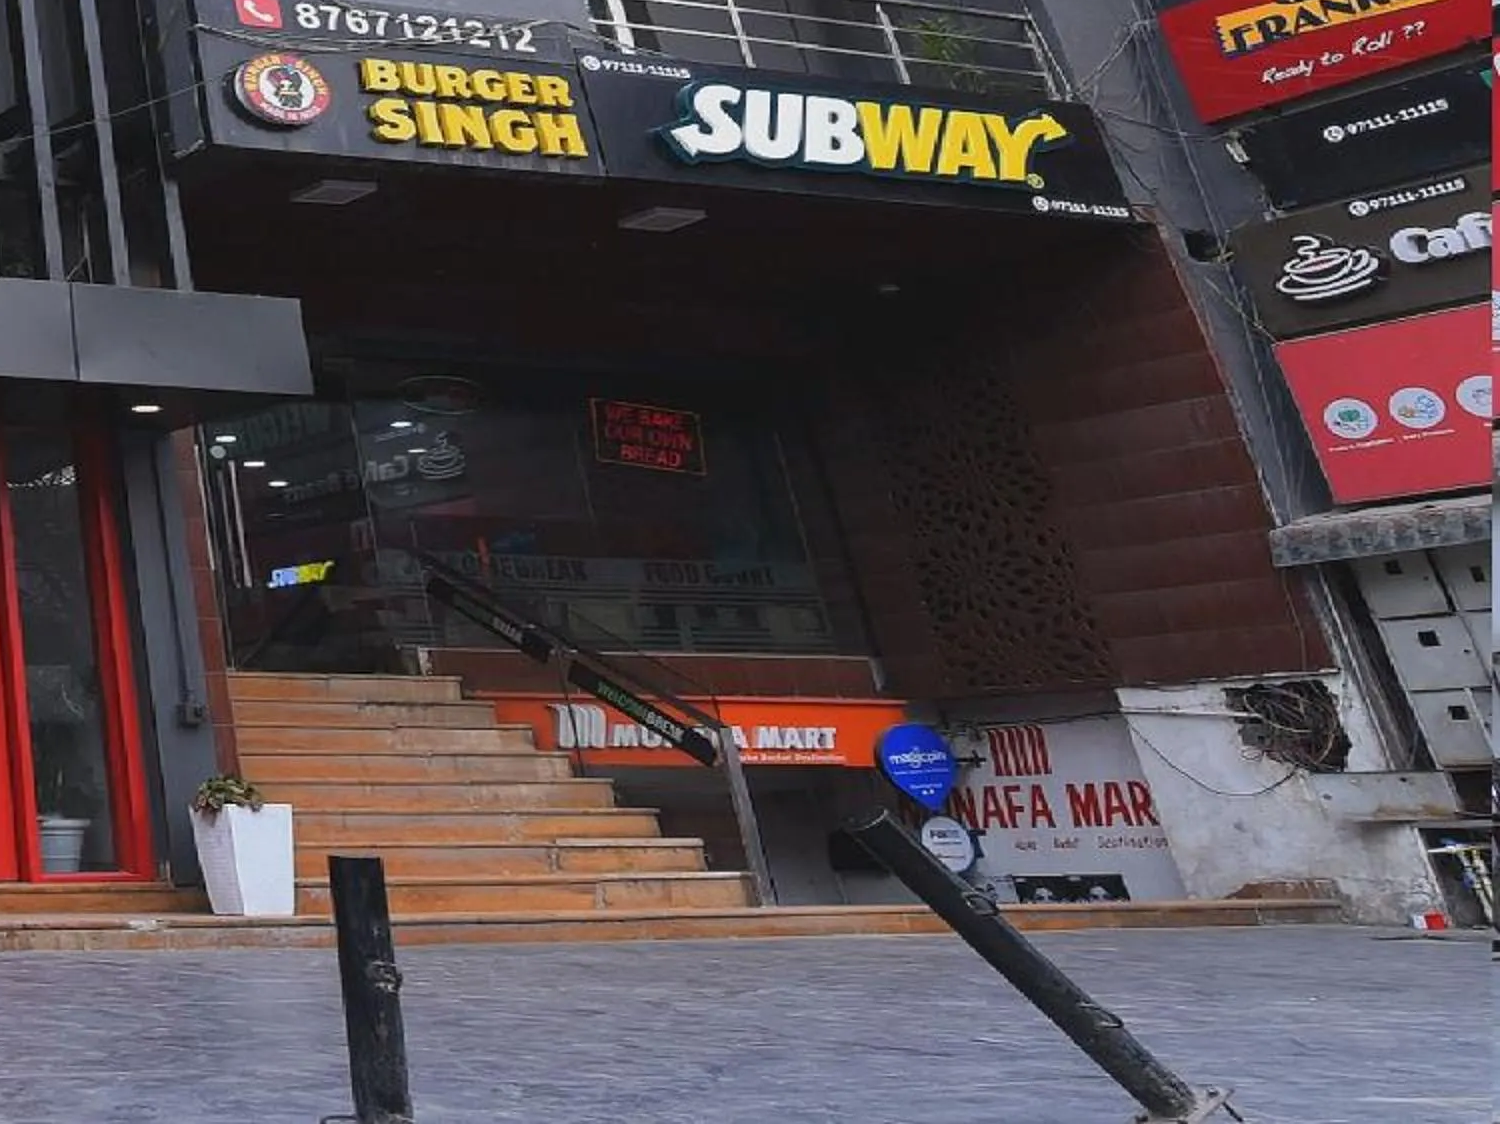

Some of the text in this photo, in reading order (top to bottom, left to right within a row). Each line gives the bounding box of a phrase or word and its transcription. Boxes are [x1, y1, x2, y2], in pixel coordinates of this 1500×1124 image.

[295, 2, 538, 54] 8767121212
[360, 57, 575, 109] BURGER
[1261, 59, 1316, 85] Ready
[1320, 50, 1346, 67] to
[1351, 29, 1395, 55] Roll
[369, 98, 589, 159] SINGH
[670, 82, 1071, 183] SUBWAY
[756, 725, 837, 749] MART
